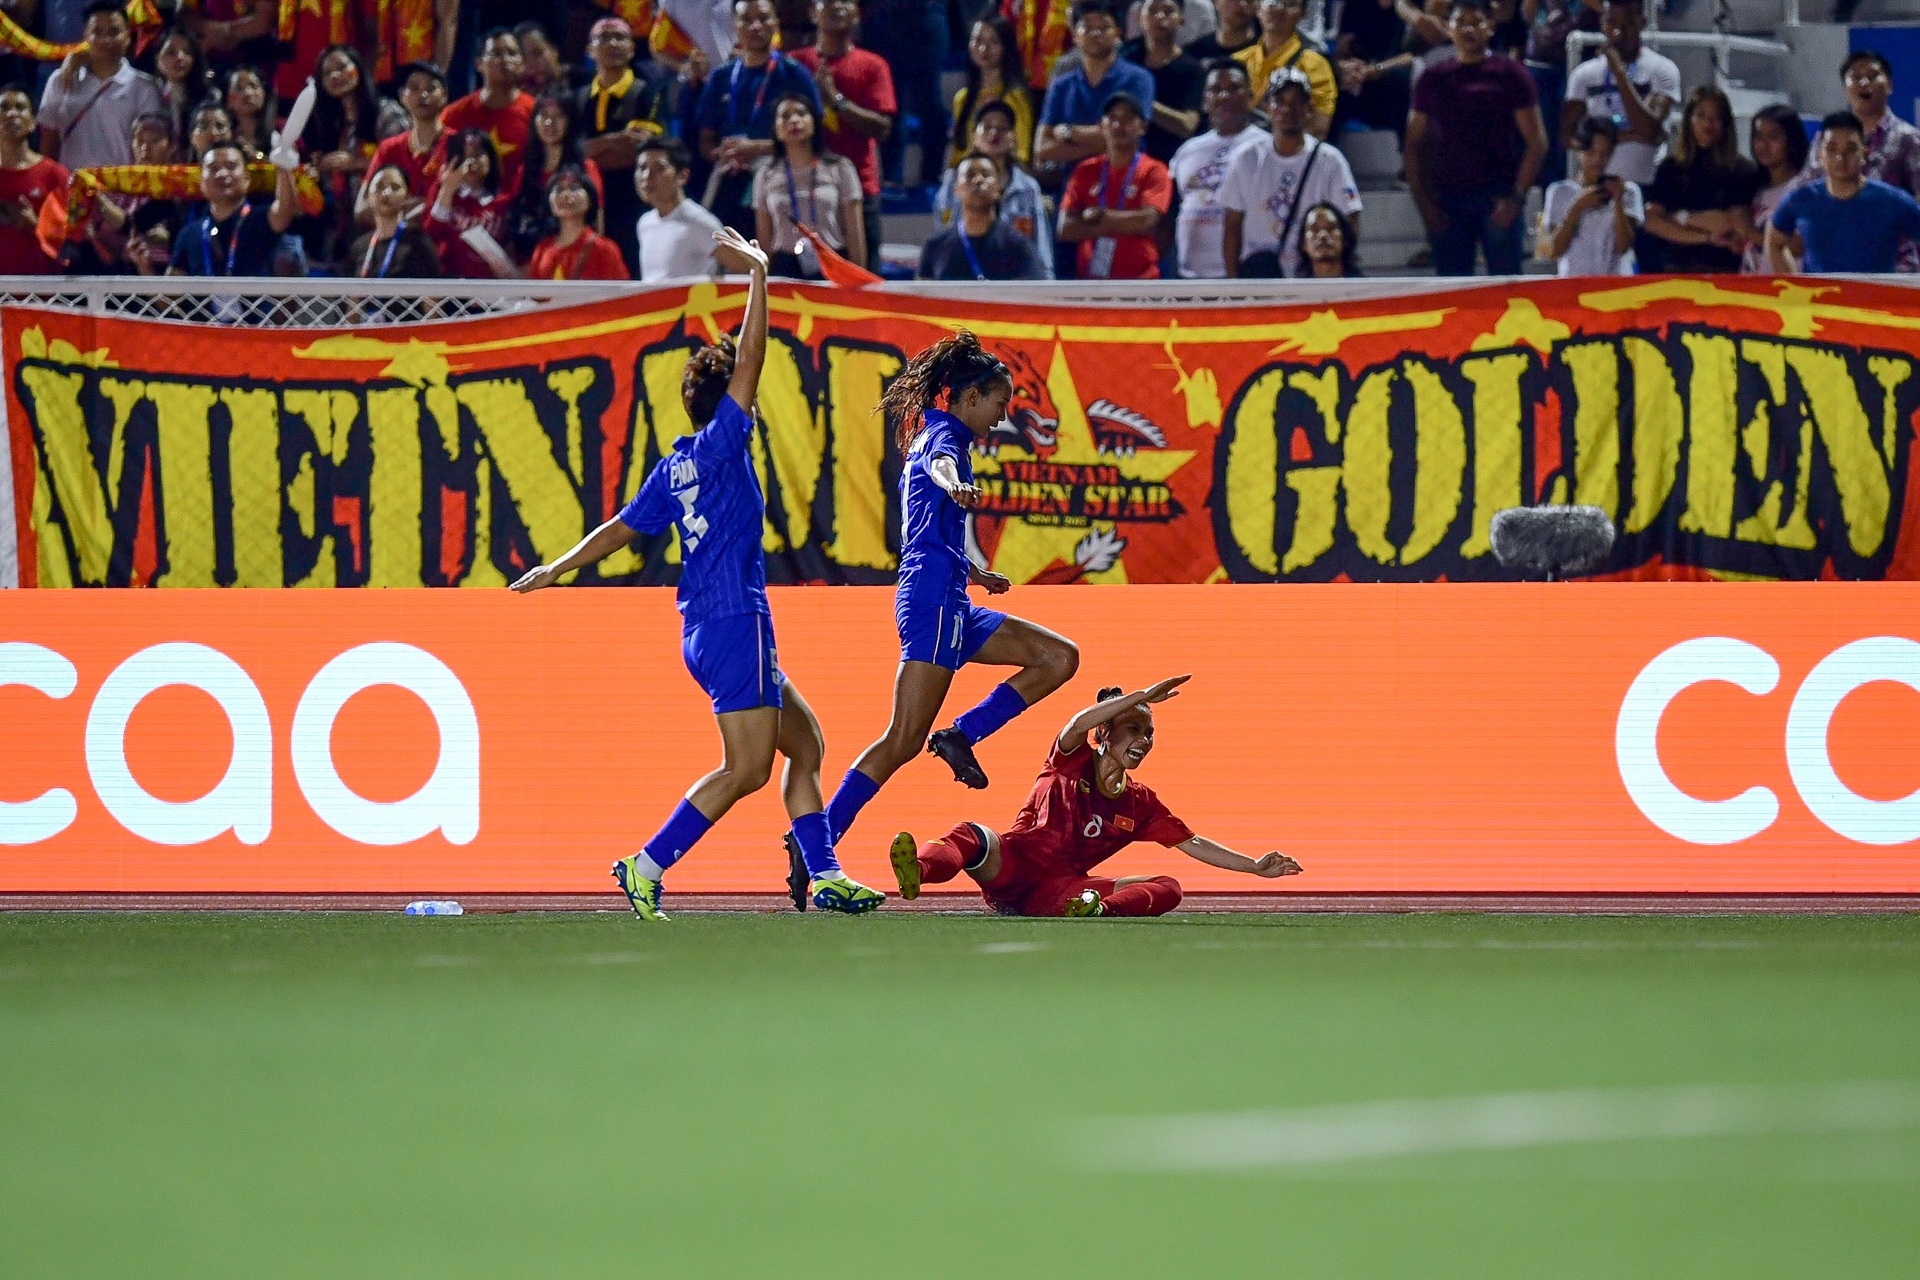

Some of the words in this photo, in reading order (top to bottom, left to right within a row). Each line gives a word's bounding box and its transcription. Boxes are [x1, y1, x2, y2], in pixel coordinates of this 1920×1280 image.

[19, 336, 902, 587] VIETNAM
[1226, 332, 1912, 574] GOLDEN
[1003, 463, 1118, 486] VIETNAM
[973, 478, 1073, 515] OLDEN
[1084, 485, 1171, 517] STAR
